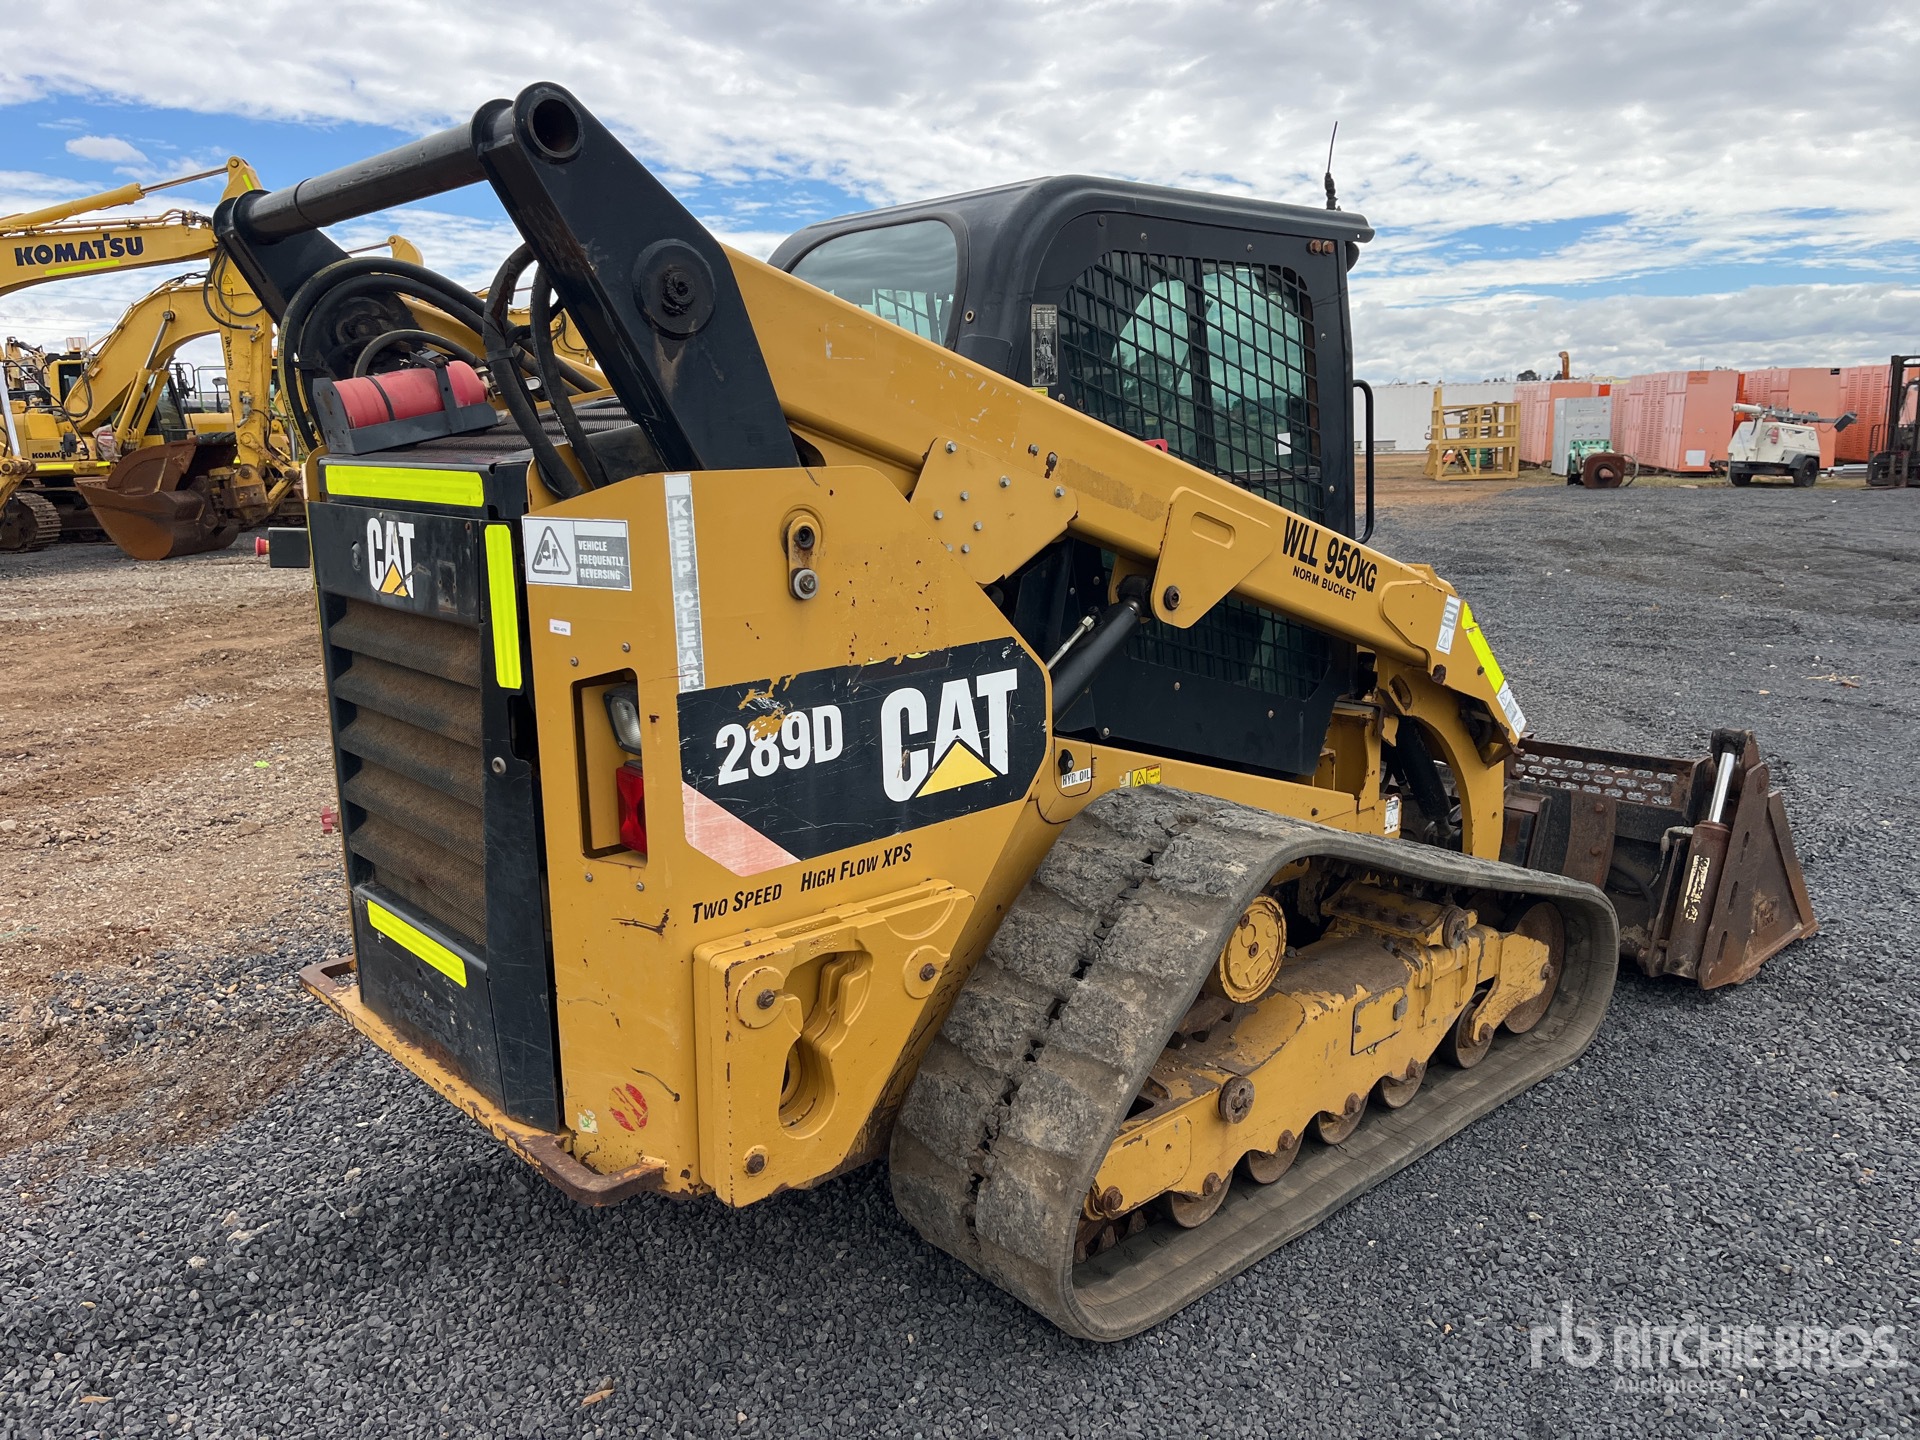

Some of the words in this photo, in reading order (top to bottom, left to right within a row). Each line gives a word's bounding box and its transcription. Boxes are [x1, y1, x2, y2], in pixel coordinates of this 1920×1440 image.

[14, 233, 144, 266] KOMATSU
[578, 540, 608, 552] VEHICLE
[671, 498, 692, 577] KEEP
[1283, 516, 1319, 568] WLL
[1324, 537, 1377, 593] 950KG
[367, 517, 415, 598] CAT
[579, 554, 624, 567] FREQUENTLY
[580, 567, 621, 580] REVERSING
[1292, 565, 1319, 586] NORM
[1321, 578, 1357, 601] BUCKET
[679, 591, 700, 687] CLEAR
[715, 704, 844, 786] 289D
[881, 668, 1018, 802] CAT
[1062, 772, 1078, 786] HYD.
[1079, 769, 1091, 781] OIL
[881, 843, 913, 868] XPS
